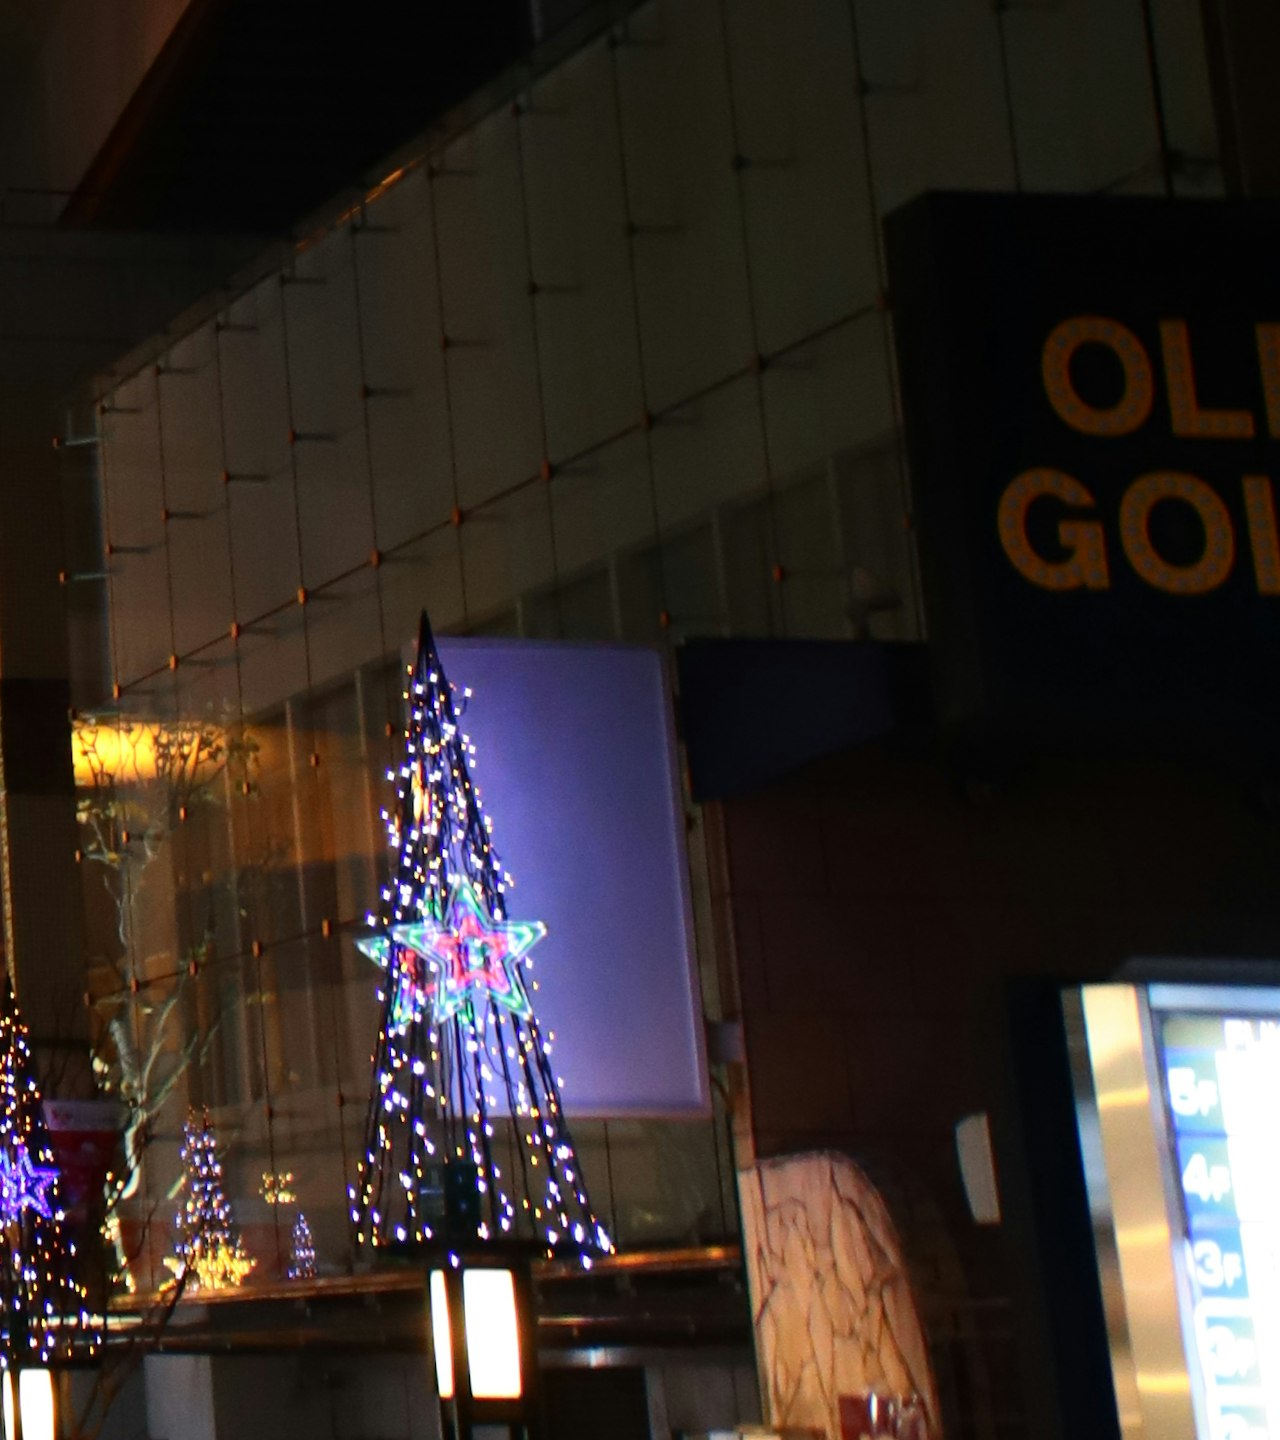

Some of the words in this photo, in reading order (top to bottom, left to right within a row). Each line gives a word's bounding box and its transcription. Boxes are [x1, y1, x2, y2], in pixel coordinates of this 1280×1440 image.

[1040, 312, 1280, 440] OL
[1167, 1066, 1218, 1117] 5F
[1181, 1152, 1231, 1203] 4F
[1192, 1238, 1242, 1288] 3F
